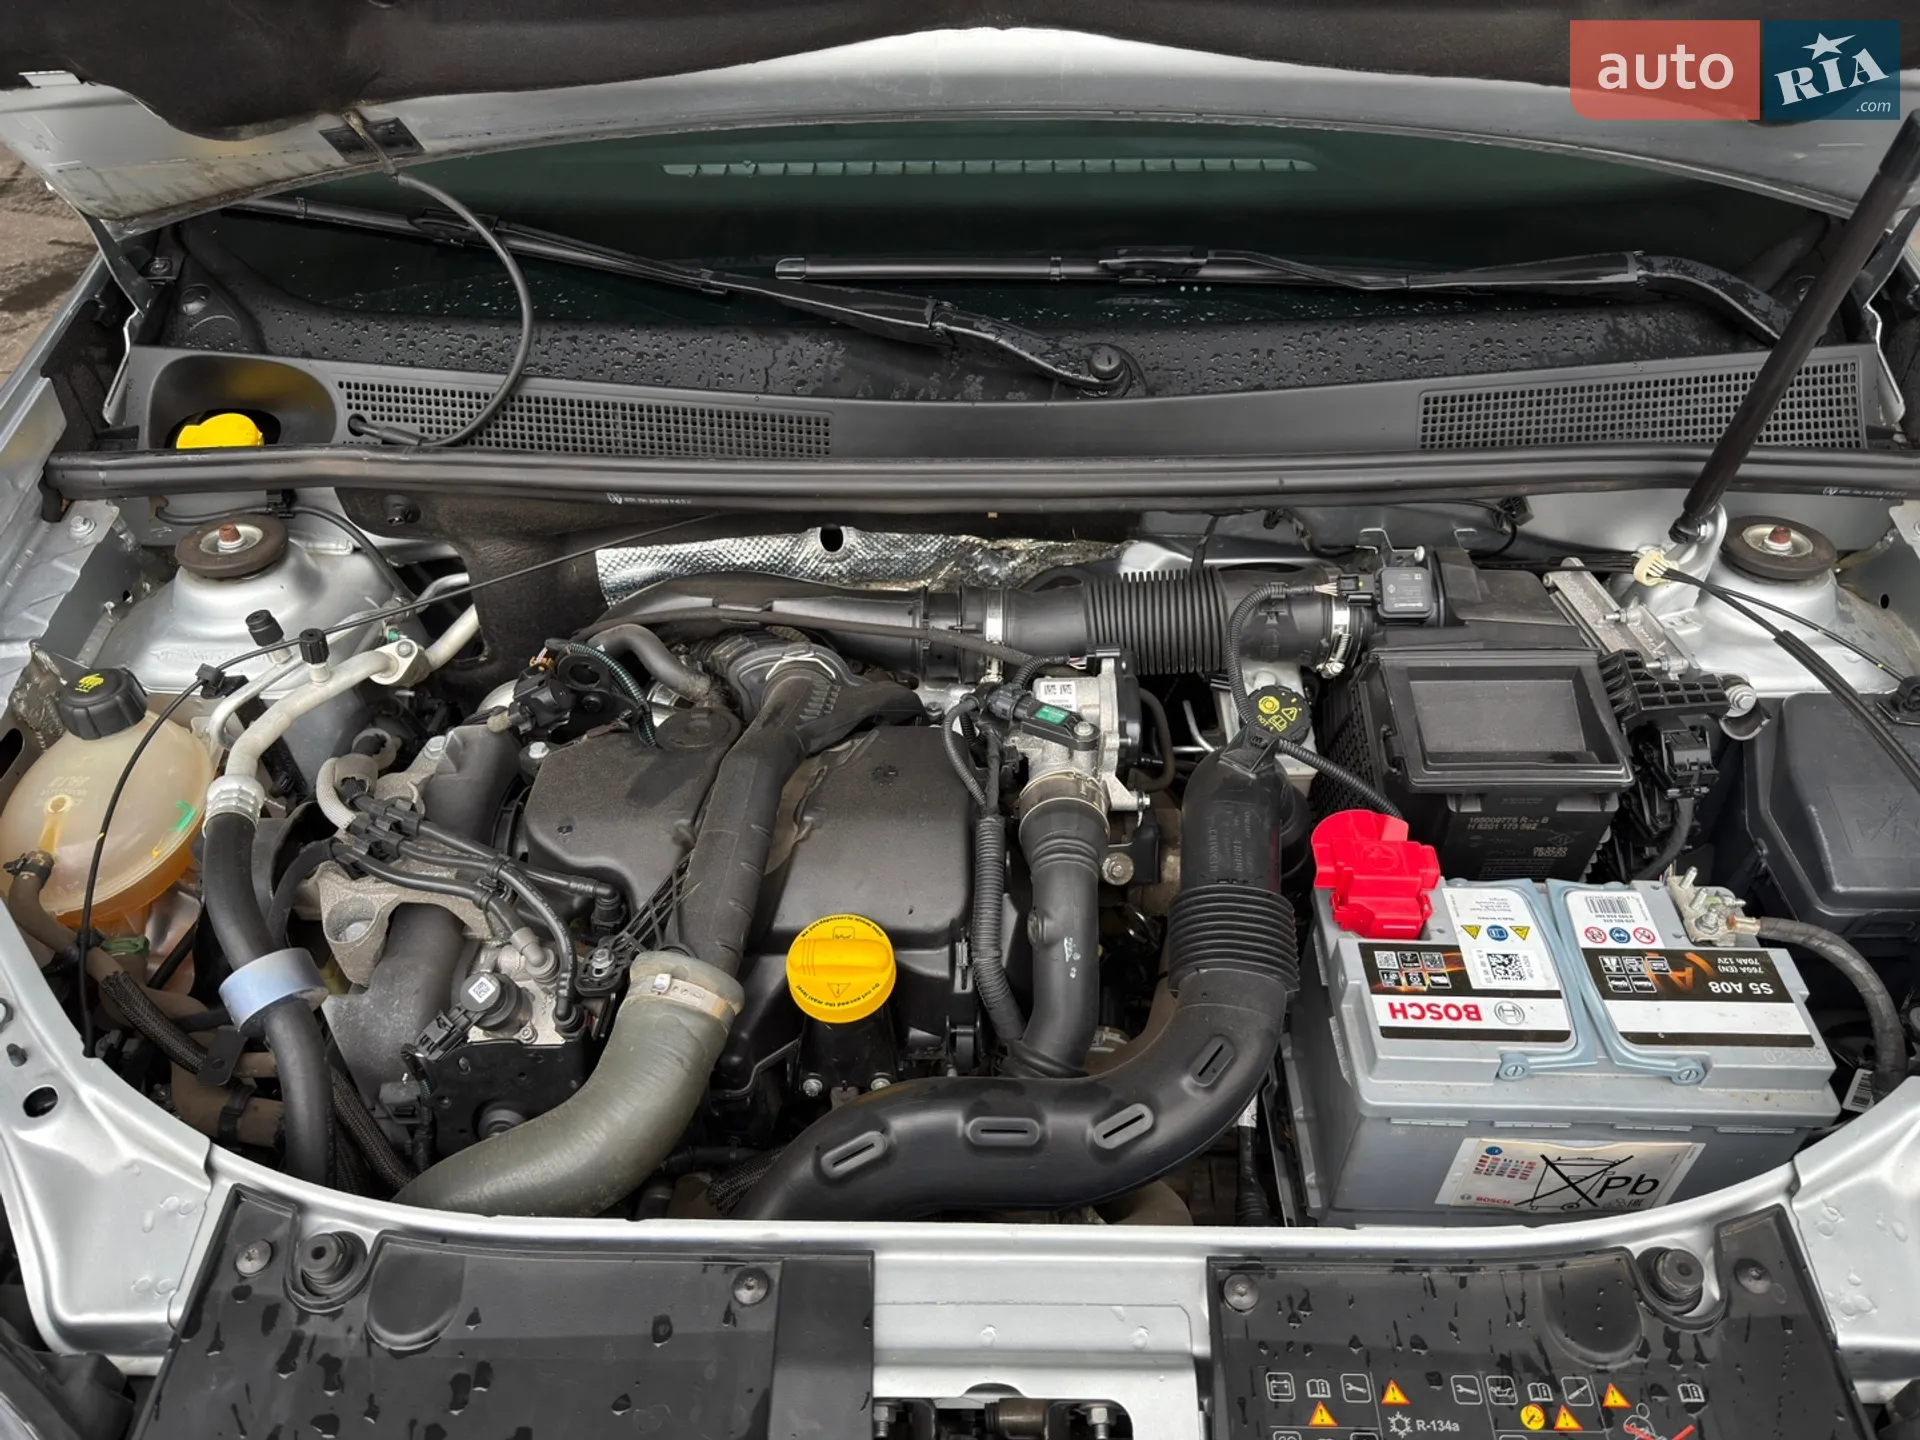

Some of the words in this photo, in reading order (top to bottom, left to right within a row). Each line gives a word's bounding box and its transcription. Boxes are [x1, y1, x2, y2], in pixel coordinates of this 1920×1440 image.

[1717, 956, 1735, 965] 12V
[1736, 957, 1760, 966] 70Ah
[1717, 964, 1738, 974] (EN)
[1739, 966, 1764, 974] 760A
[1708, 981, 1743, 994] A08
[1748, 982, 1774, 995] S5
[861, 989, 871, 999] not
[837, 996, 861, 1007] exceed
[1388, 1002, 1482, 1022] BOSCH
[1596, 1173, 1660, 1198] Pb
[1475, 1196, 1511, 1206] BOSCH
[1416, 1419, 1460, 1432] R-134a
